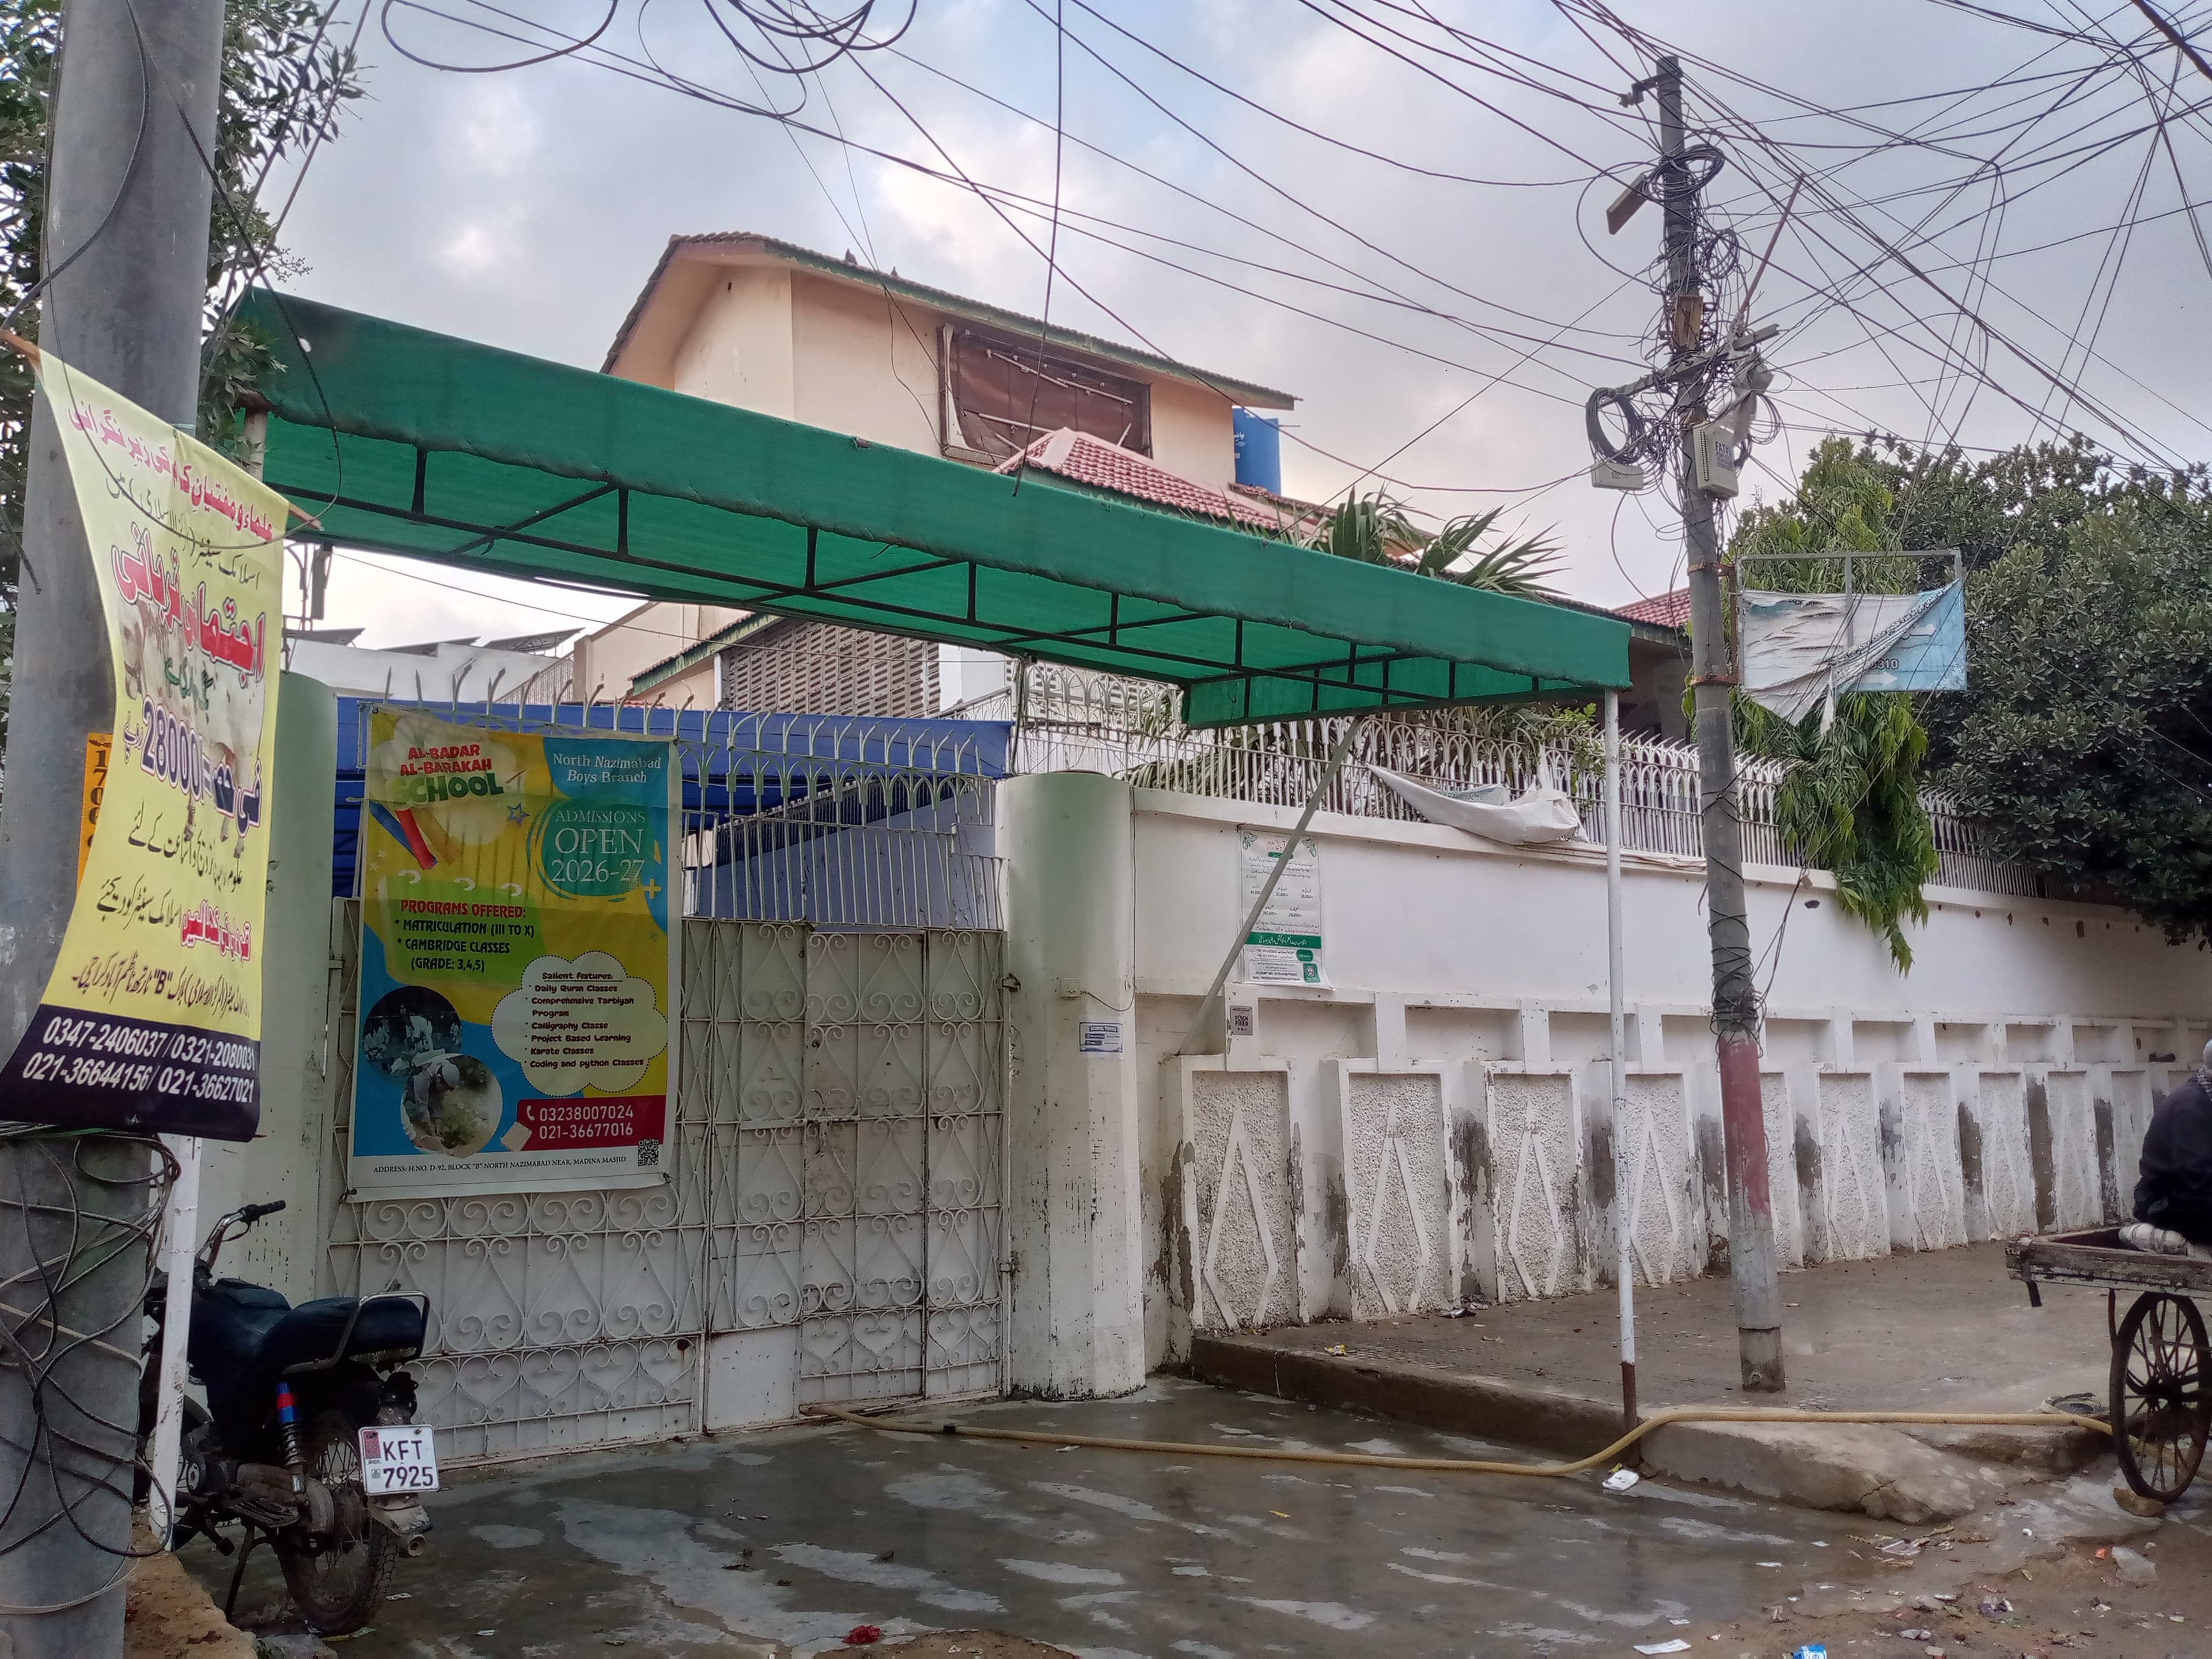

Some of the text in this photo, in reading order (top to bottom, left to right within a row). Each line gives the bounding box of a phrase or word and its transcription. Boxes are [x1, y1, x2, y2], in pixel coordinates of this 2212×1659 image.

[182, 581, 266, 690] اجتمای
[408, 744, 480, 760] AL-BADAR
[400, 758, 492, 776] AL-BARAKAH
[552, 753, 661, 769] North Nazimabad
[567, 769, 647, 785] Boys Branch
[555, 810, 645, 824] ADMISSIONS
[555, 827, 644, 854] OPEN
[551, 859, 645, 882] 2026-27
[400, 899, 526, 918] PROGRAMS OFFERED:
[403, 919, 535, 938] MATRICULATION (III TO X)
[405, 938, 510, 954] CAMBRIDGE CLASSES
[411, 957, 484, 974] (GRADE: 3,4,5)
[535, 984, 557, 993] Daily
[597, 997, 634, 1006] Tarbiyah
[532, 1010, 569, 1018] Program
[531, 1022, 578, 1031] Calligraphy
[531, 1035, 562, 1043] Project
[594, 1034, 631, 1043] Learning
[530, 1060, 558, 1069] Coding
[579, 1059, 609, 1069] python
[157, 1067, 255, 1103] 021-36627021
[540, 1105, 634, 1122] 03238007024
[539, 1123, 633, 1139] 021-36677016
[510, 1160, 551, 1168] NAZIMABAD
[382, 1440, 423, 1461] KFT
[383, 1466, 434, 1488] 7925
